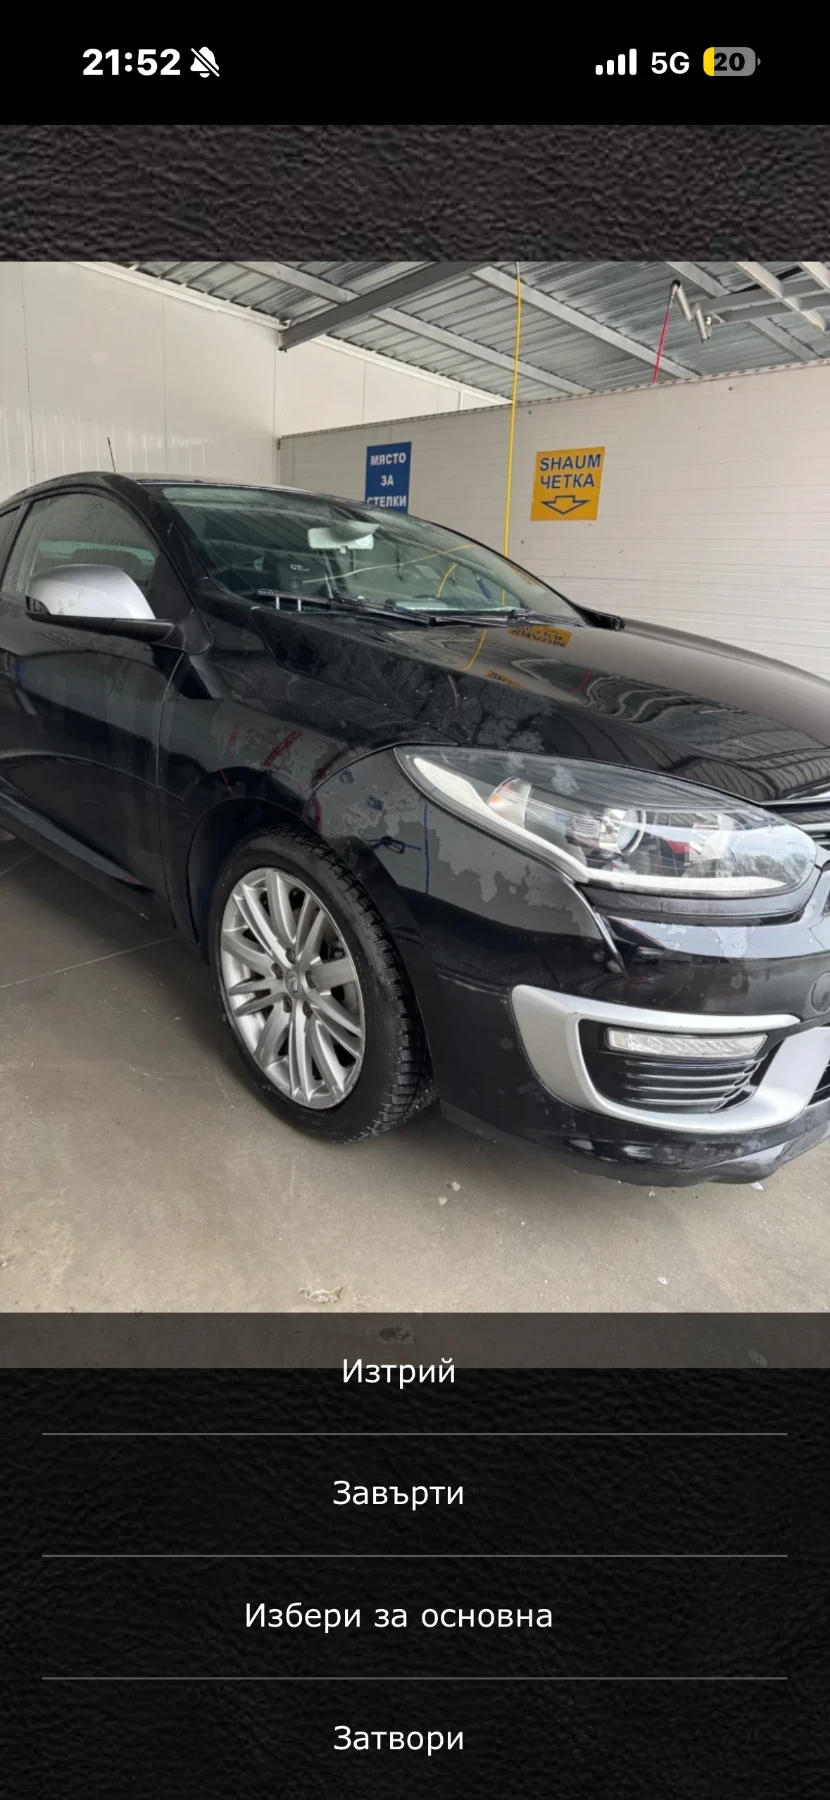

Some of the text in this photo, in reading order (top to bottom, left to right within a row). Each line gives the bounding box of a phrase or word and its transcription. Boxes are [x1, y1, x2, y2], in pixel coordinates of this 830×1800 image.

[370, 452, 406, 466] МЯСТО
[540, 453, 601, 471] SHAUM
[380, 474, 394, 487] ЗА
[540, 473, 595, 489] ЧЕТКА
[366, 495, 407, 507] СТЕЛКИ
